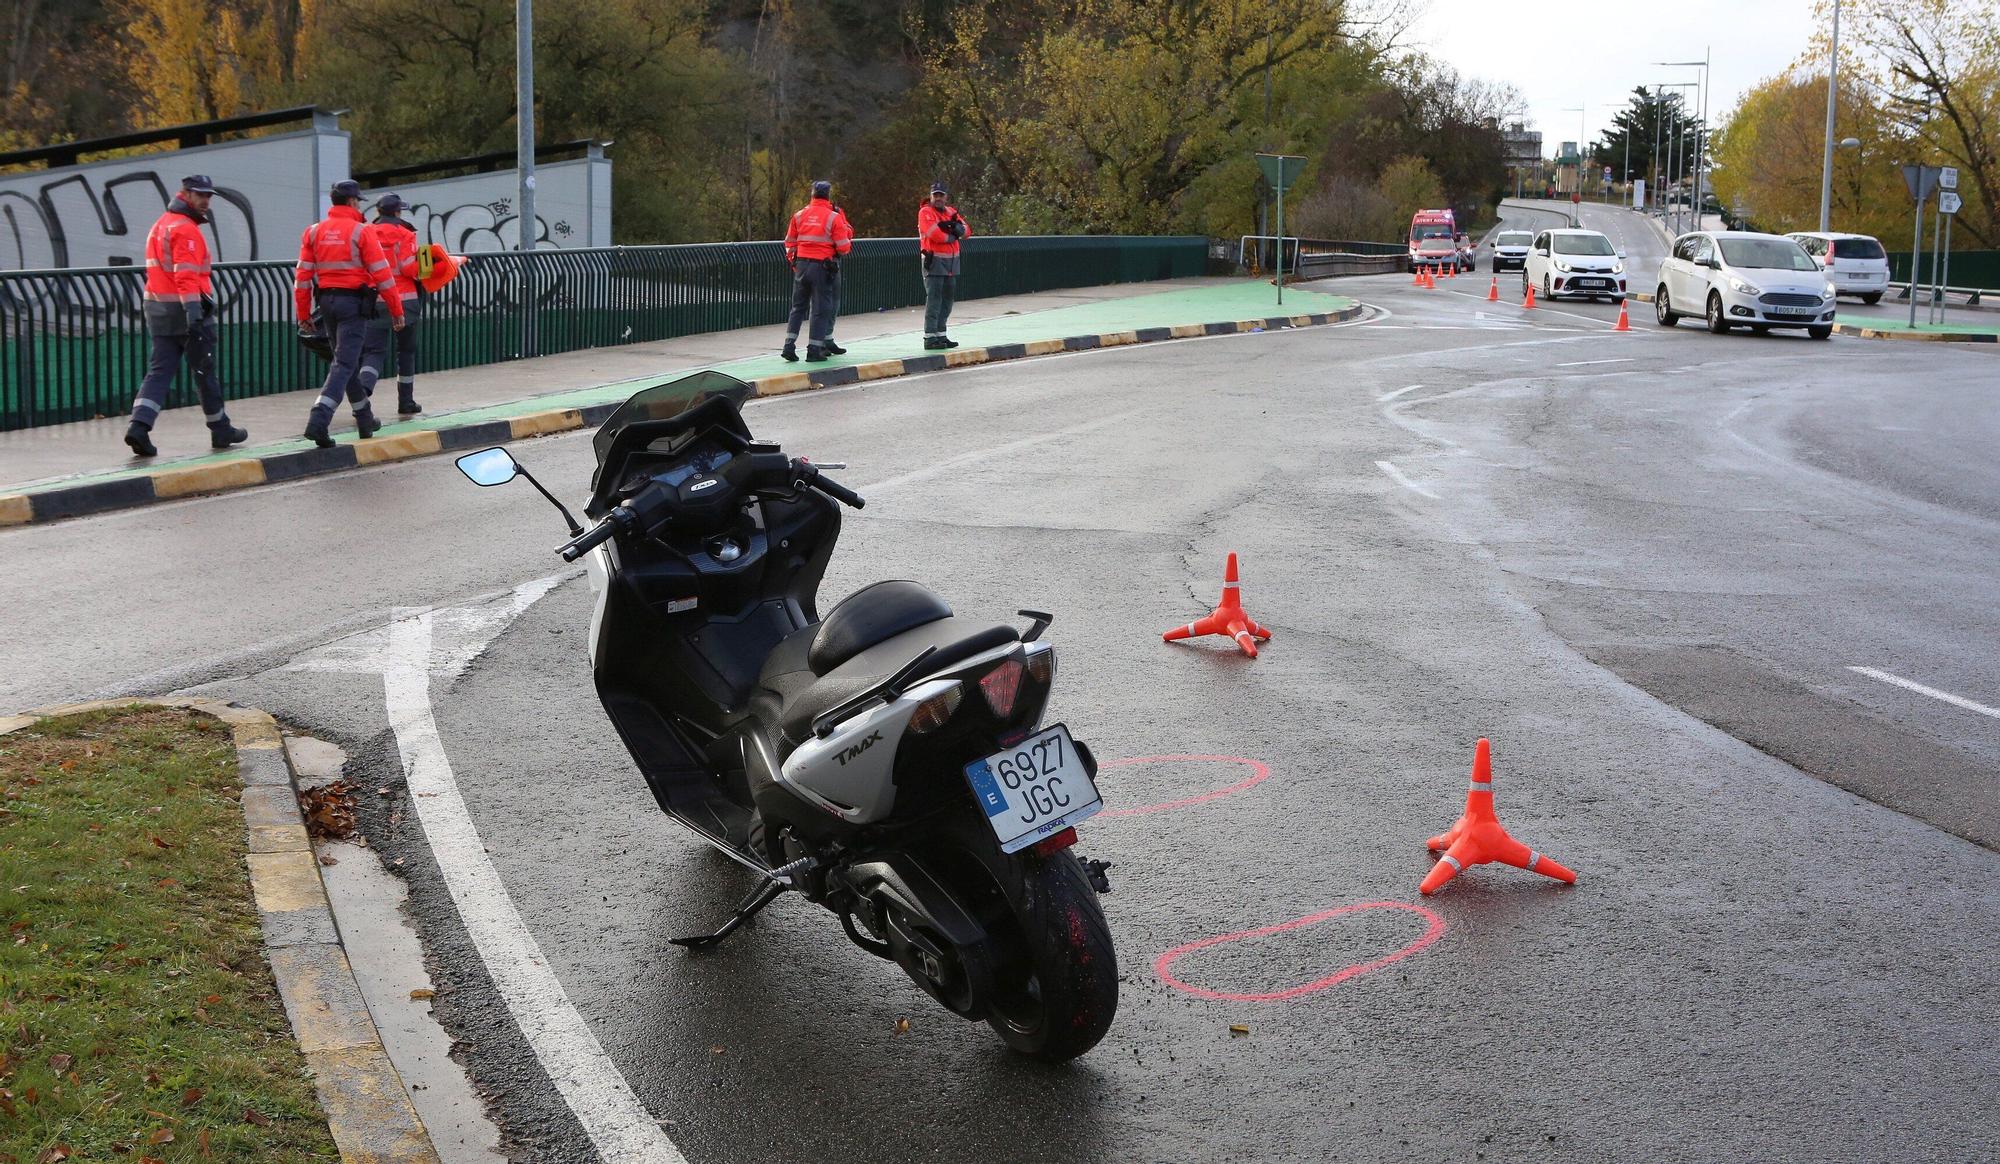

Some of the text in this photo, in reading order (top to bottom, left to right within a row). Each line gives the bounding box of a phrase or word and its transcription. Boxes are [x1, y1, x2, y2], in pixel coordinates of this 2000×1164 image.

[422, 249, 429, 267] 1
[997, 734, 1063, 790] 6927
[987, 792, 998, 806] E
[1021, 777, 1070, 823] JGC
